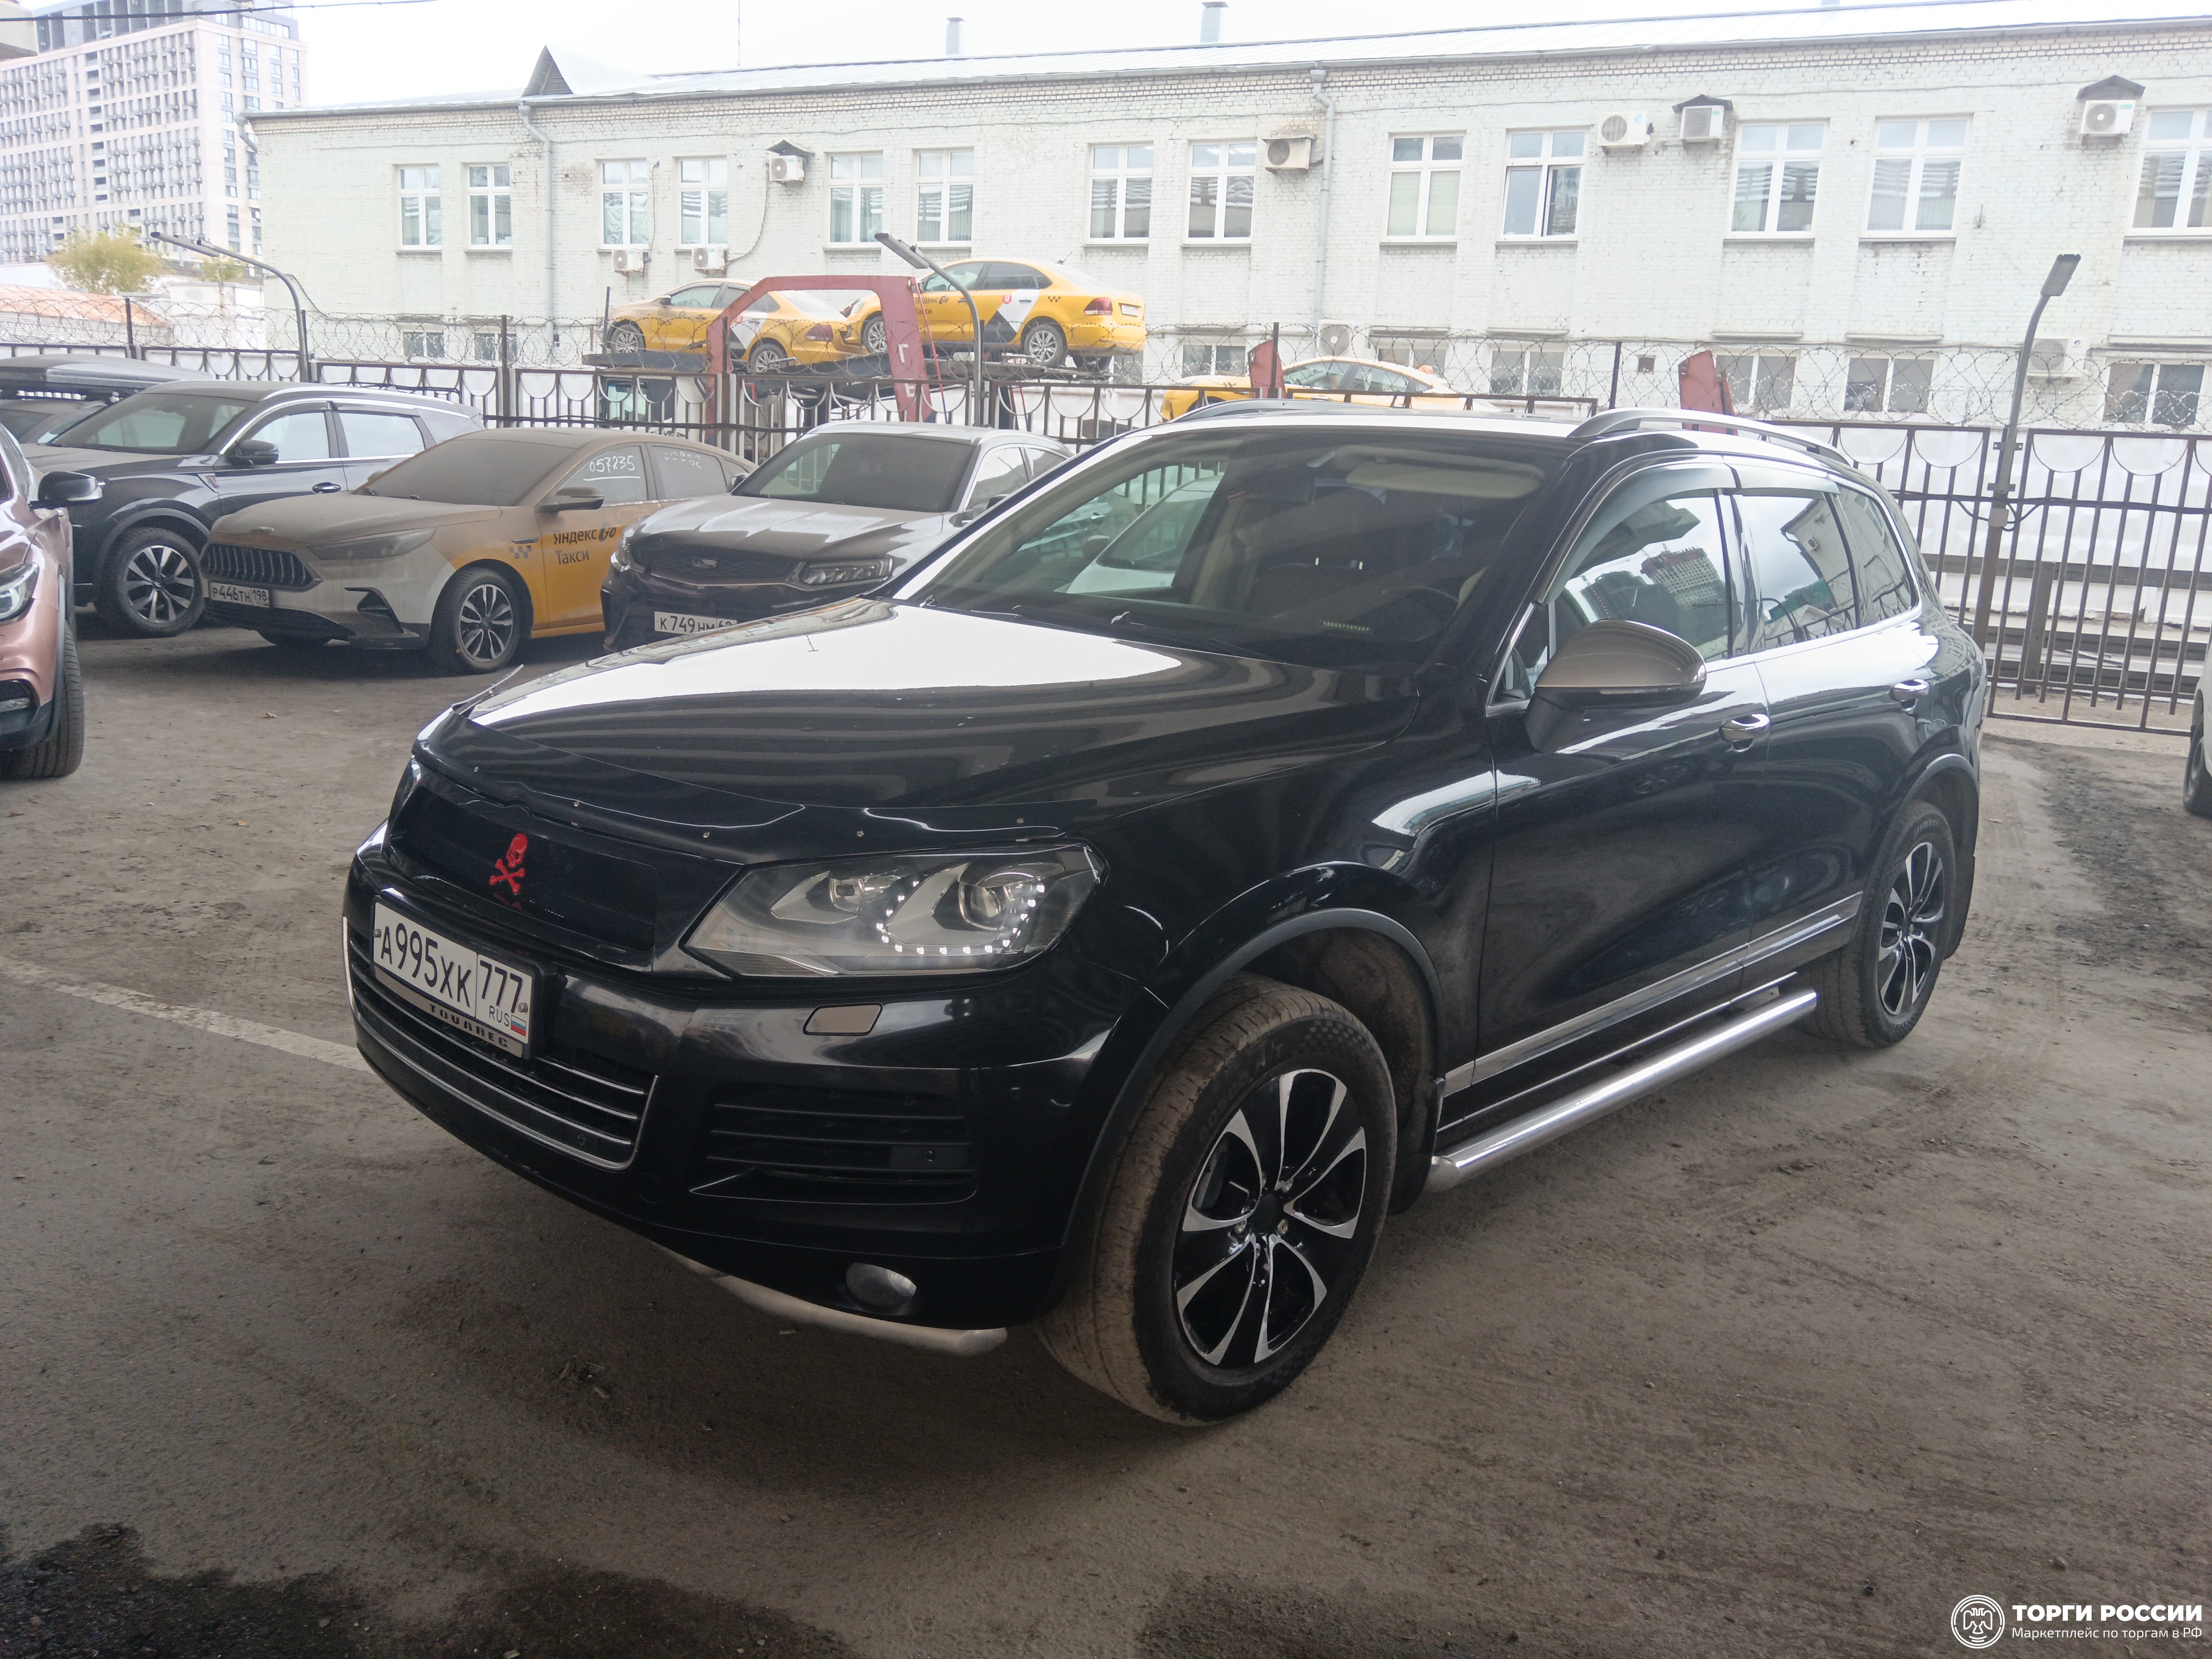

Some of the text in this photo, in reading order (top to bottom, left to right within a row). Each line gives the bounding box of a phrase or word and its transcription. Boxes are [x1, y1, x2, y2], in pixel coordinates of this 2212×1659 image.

[553, 529, 597, 545] Яндекс
[555, 550, 589, 565] Такси
[480, 959, 522, 1013] 777
[489, 1005, 510, 1027] RUS
